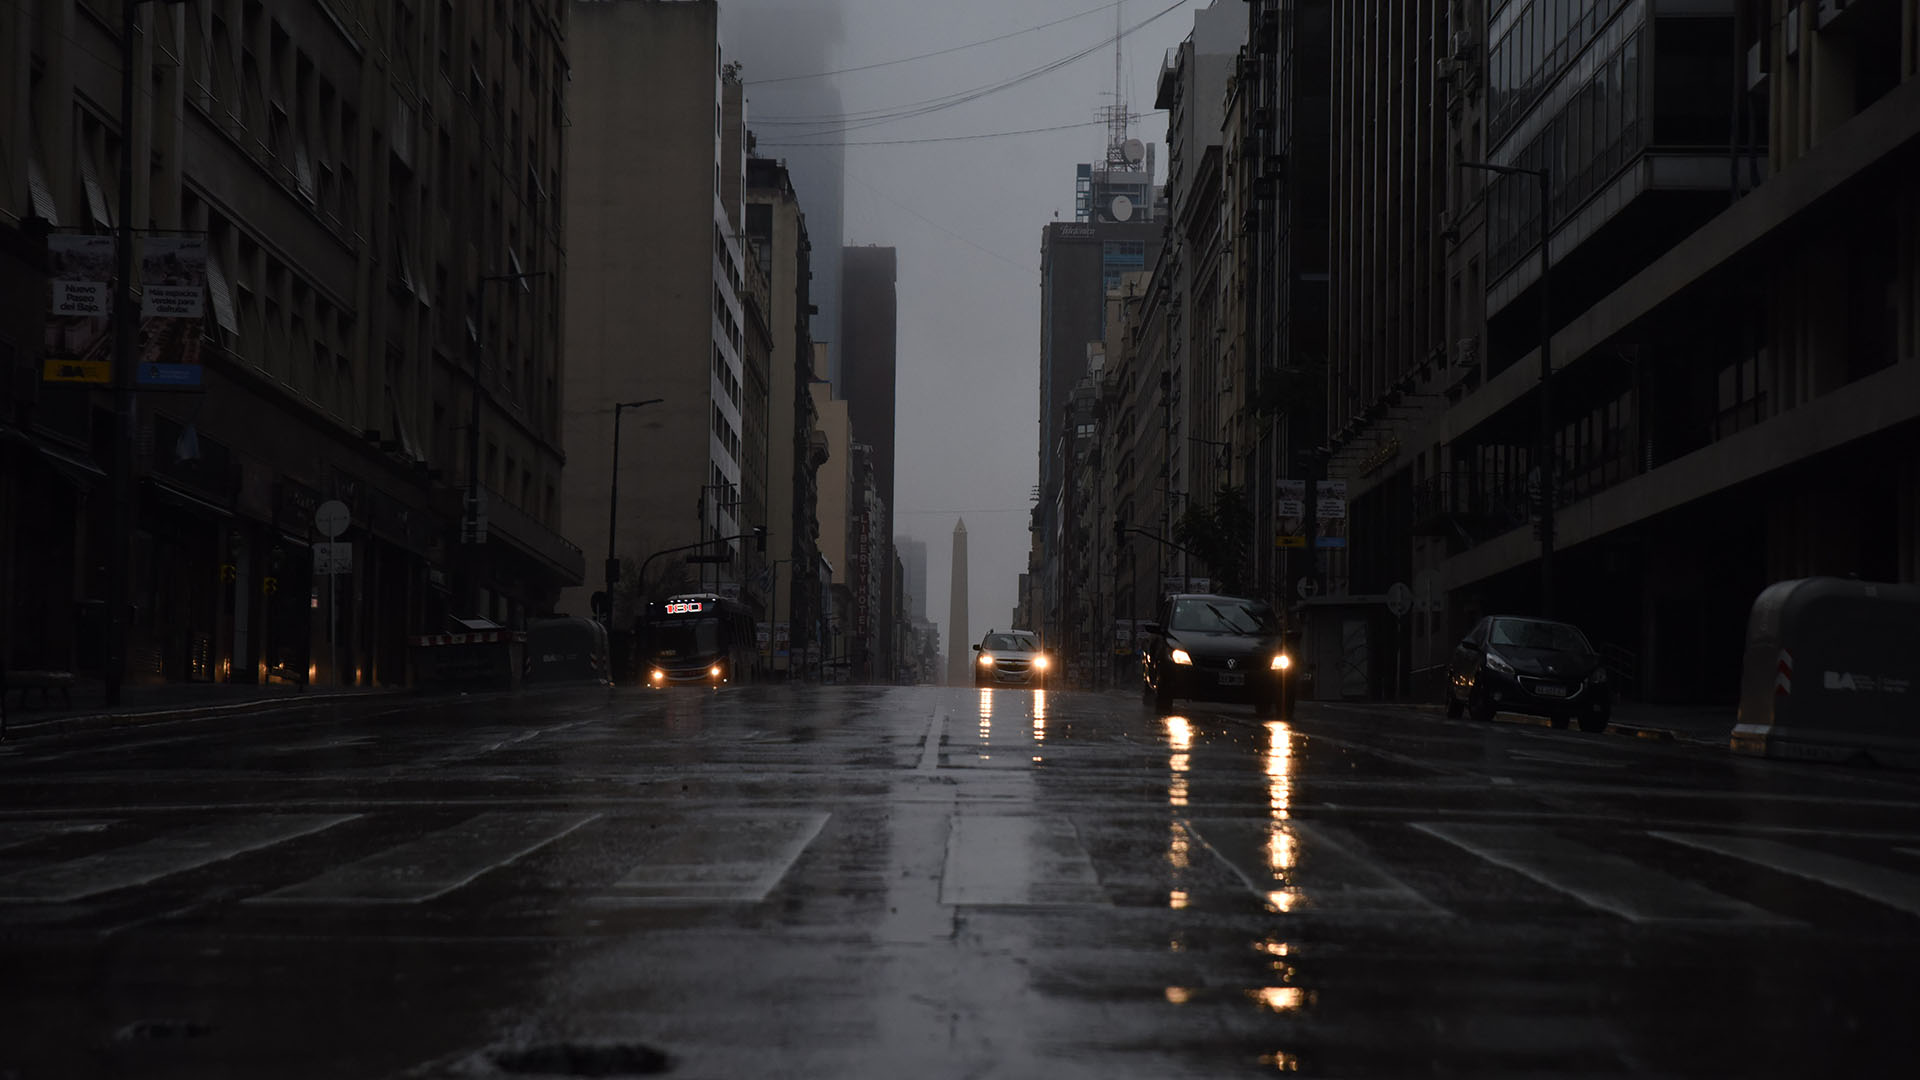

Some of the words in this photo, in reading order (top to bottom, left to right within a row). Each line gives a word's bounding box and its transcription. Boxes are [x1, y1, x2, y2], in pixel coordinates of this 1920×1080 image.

[65, 284, 96, 293] Nuevo
[66, 293, 94, 302] Paseo
[60, 302, 75, 311] del
[665, 602, 702, 615] 180
